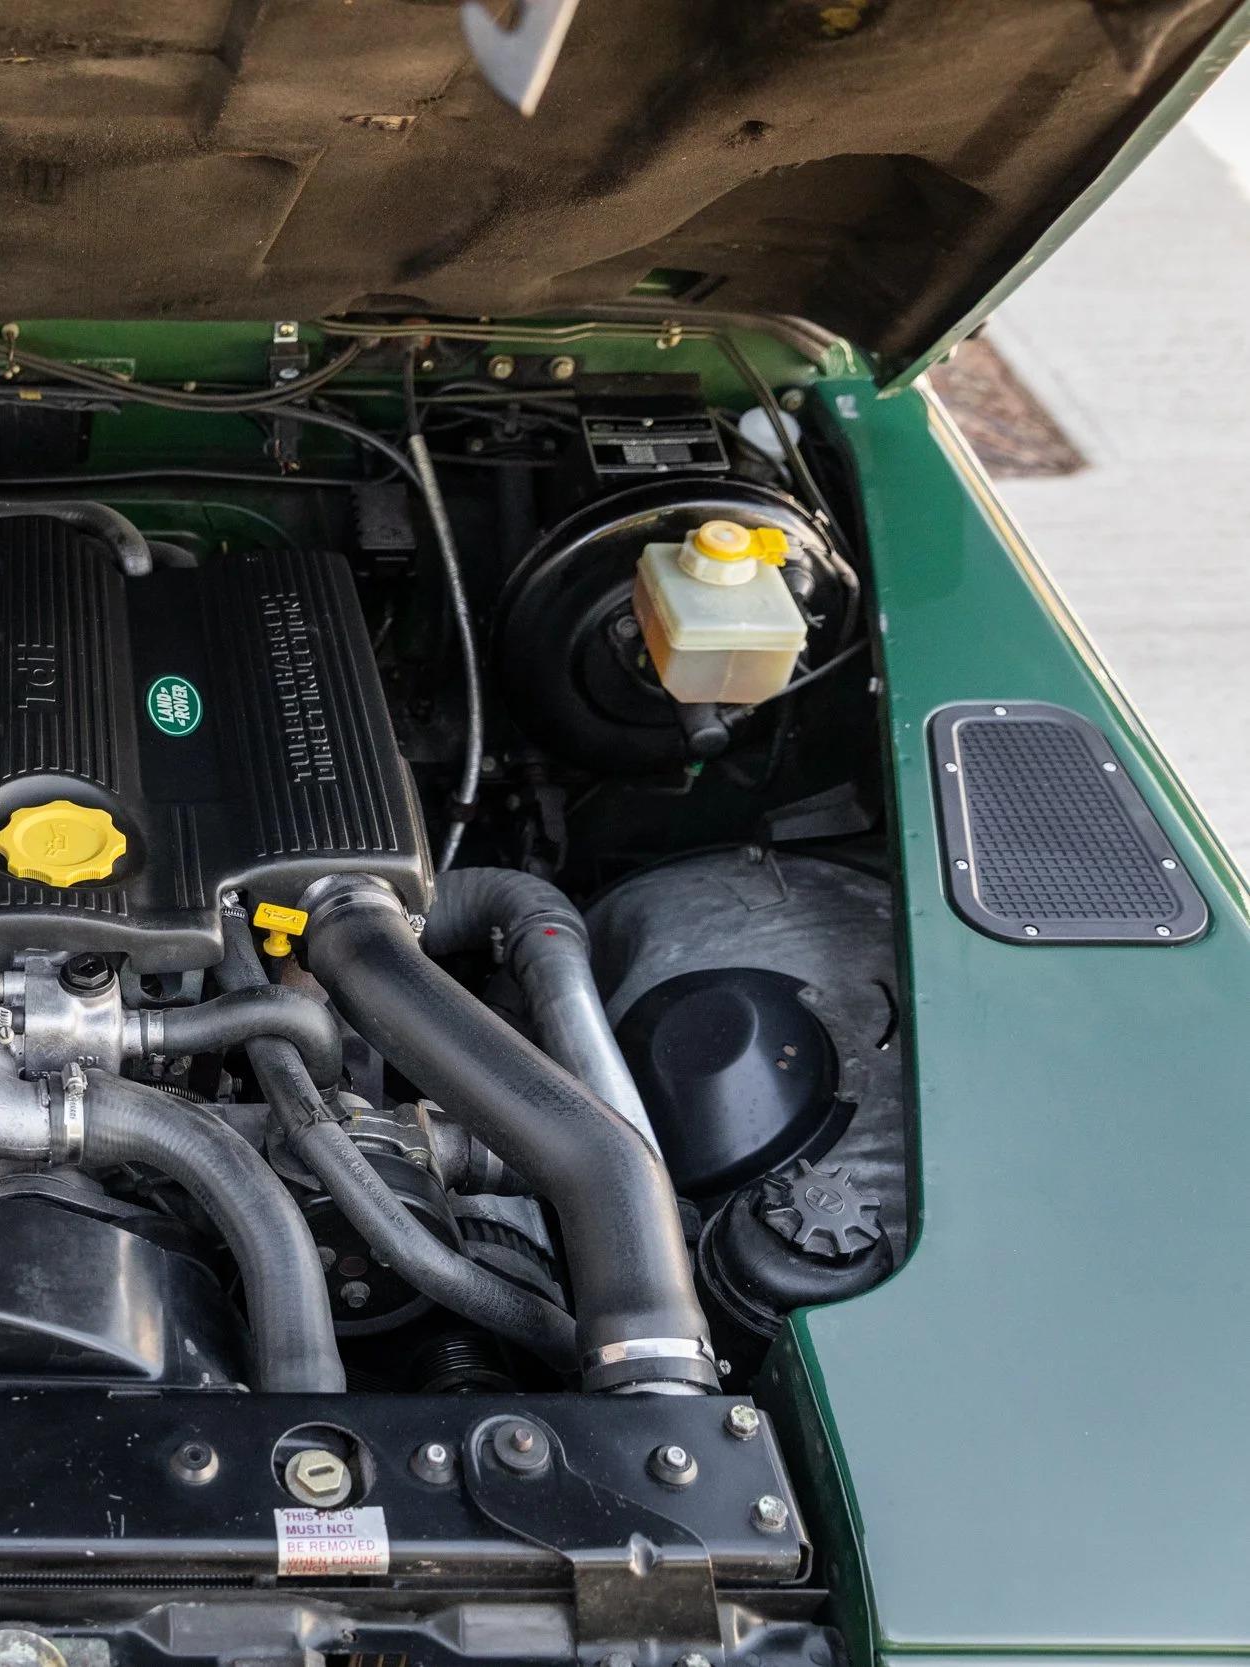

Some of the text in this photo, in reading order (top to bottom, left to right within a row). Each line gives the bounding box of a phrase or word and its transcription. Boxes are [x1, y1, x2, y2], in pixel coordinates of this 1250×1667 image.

[156, 686, 174, 723] LAND
[171, 684, 190, 727] ROVER
[284, 1510, 354, 1522] THIS PLG
[286, 1523, 354, 1535] MUST NOT
[287, 1539, 375, 1553] BE REMOVED
[287, 1554, 382, 1567] WHEN ENGINE
